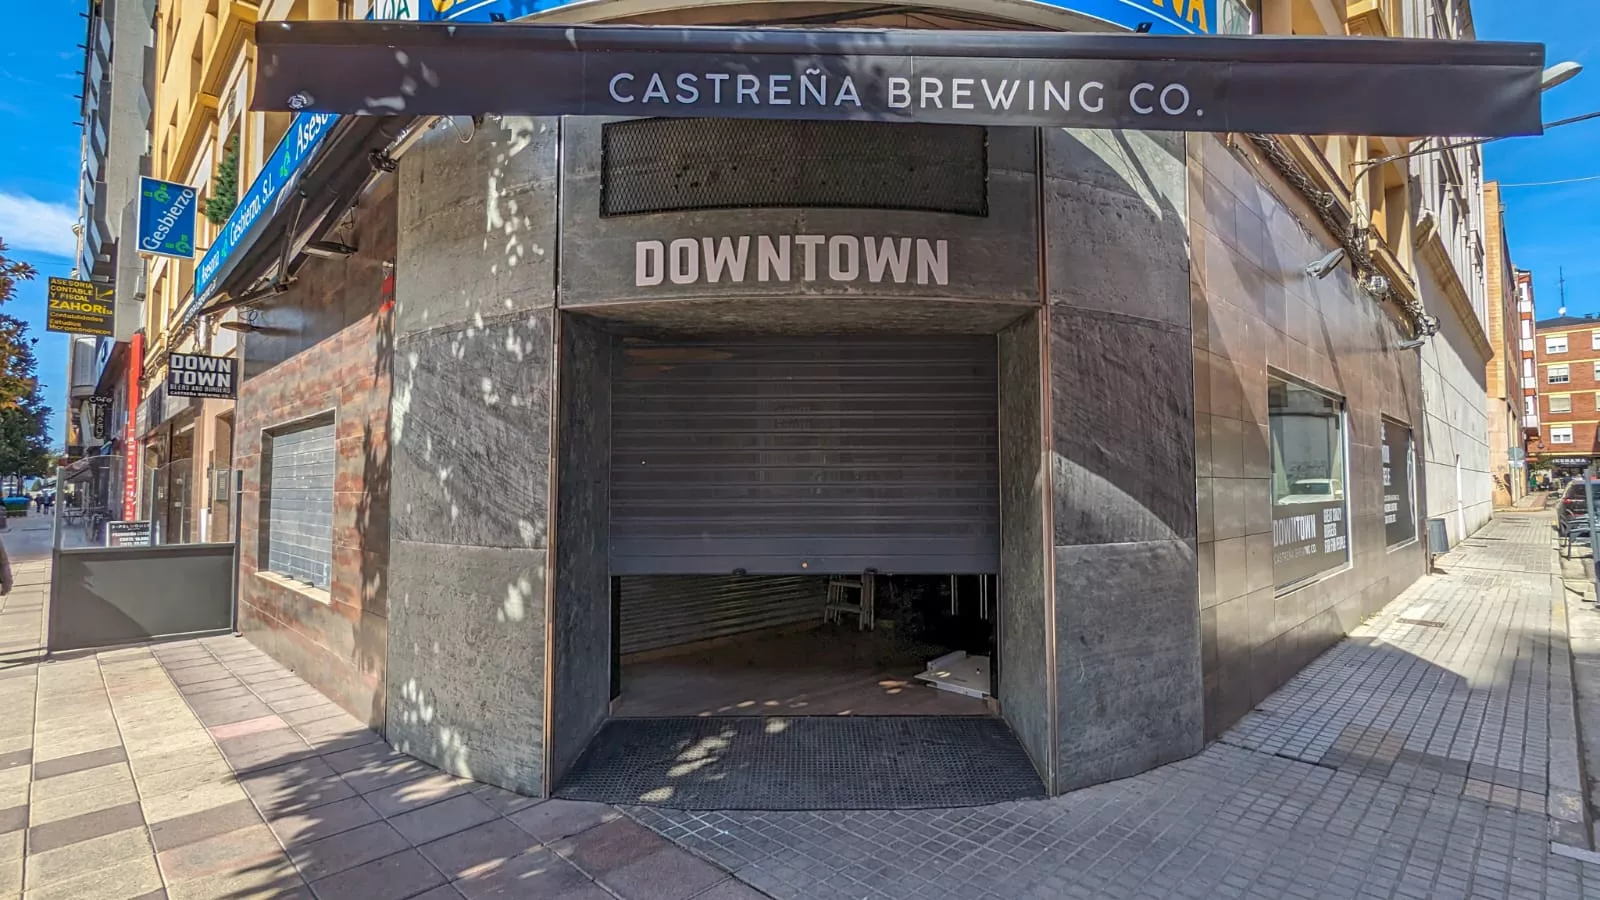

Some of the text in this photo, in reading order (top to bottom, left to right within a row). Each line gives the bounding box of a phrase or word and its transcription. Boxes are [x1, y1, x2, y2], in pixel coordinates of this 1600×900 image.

[608, 68, 1204, 116] CASTREÑA BREWING CO.
[143, 189, 194, 249] Gesbierzo
[636, 235, 948, 287] DOWNTOWN
[171, 355, 231, 373] DOWN
[171, 370, 231, 388] TOWN
[1273, 514, 1317, 548] DOWNTOWN
